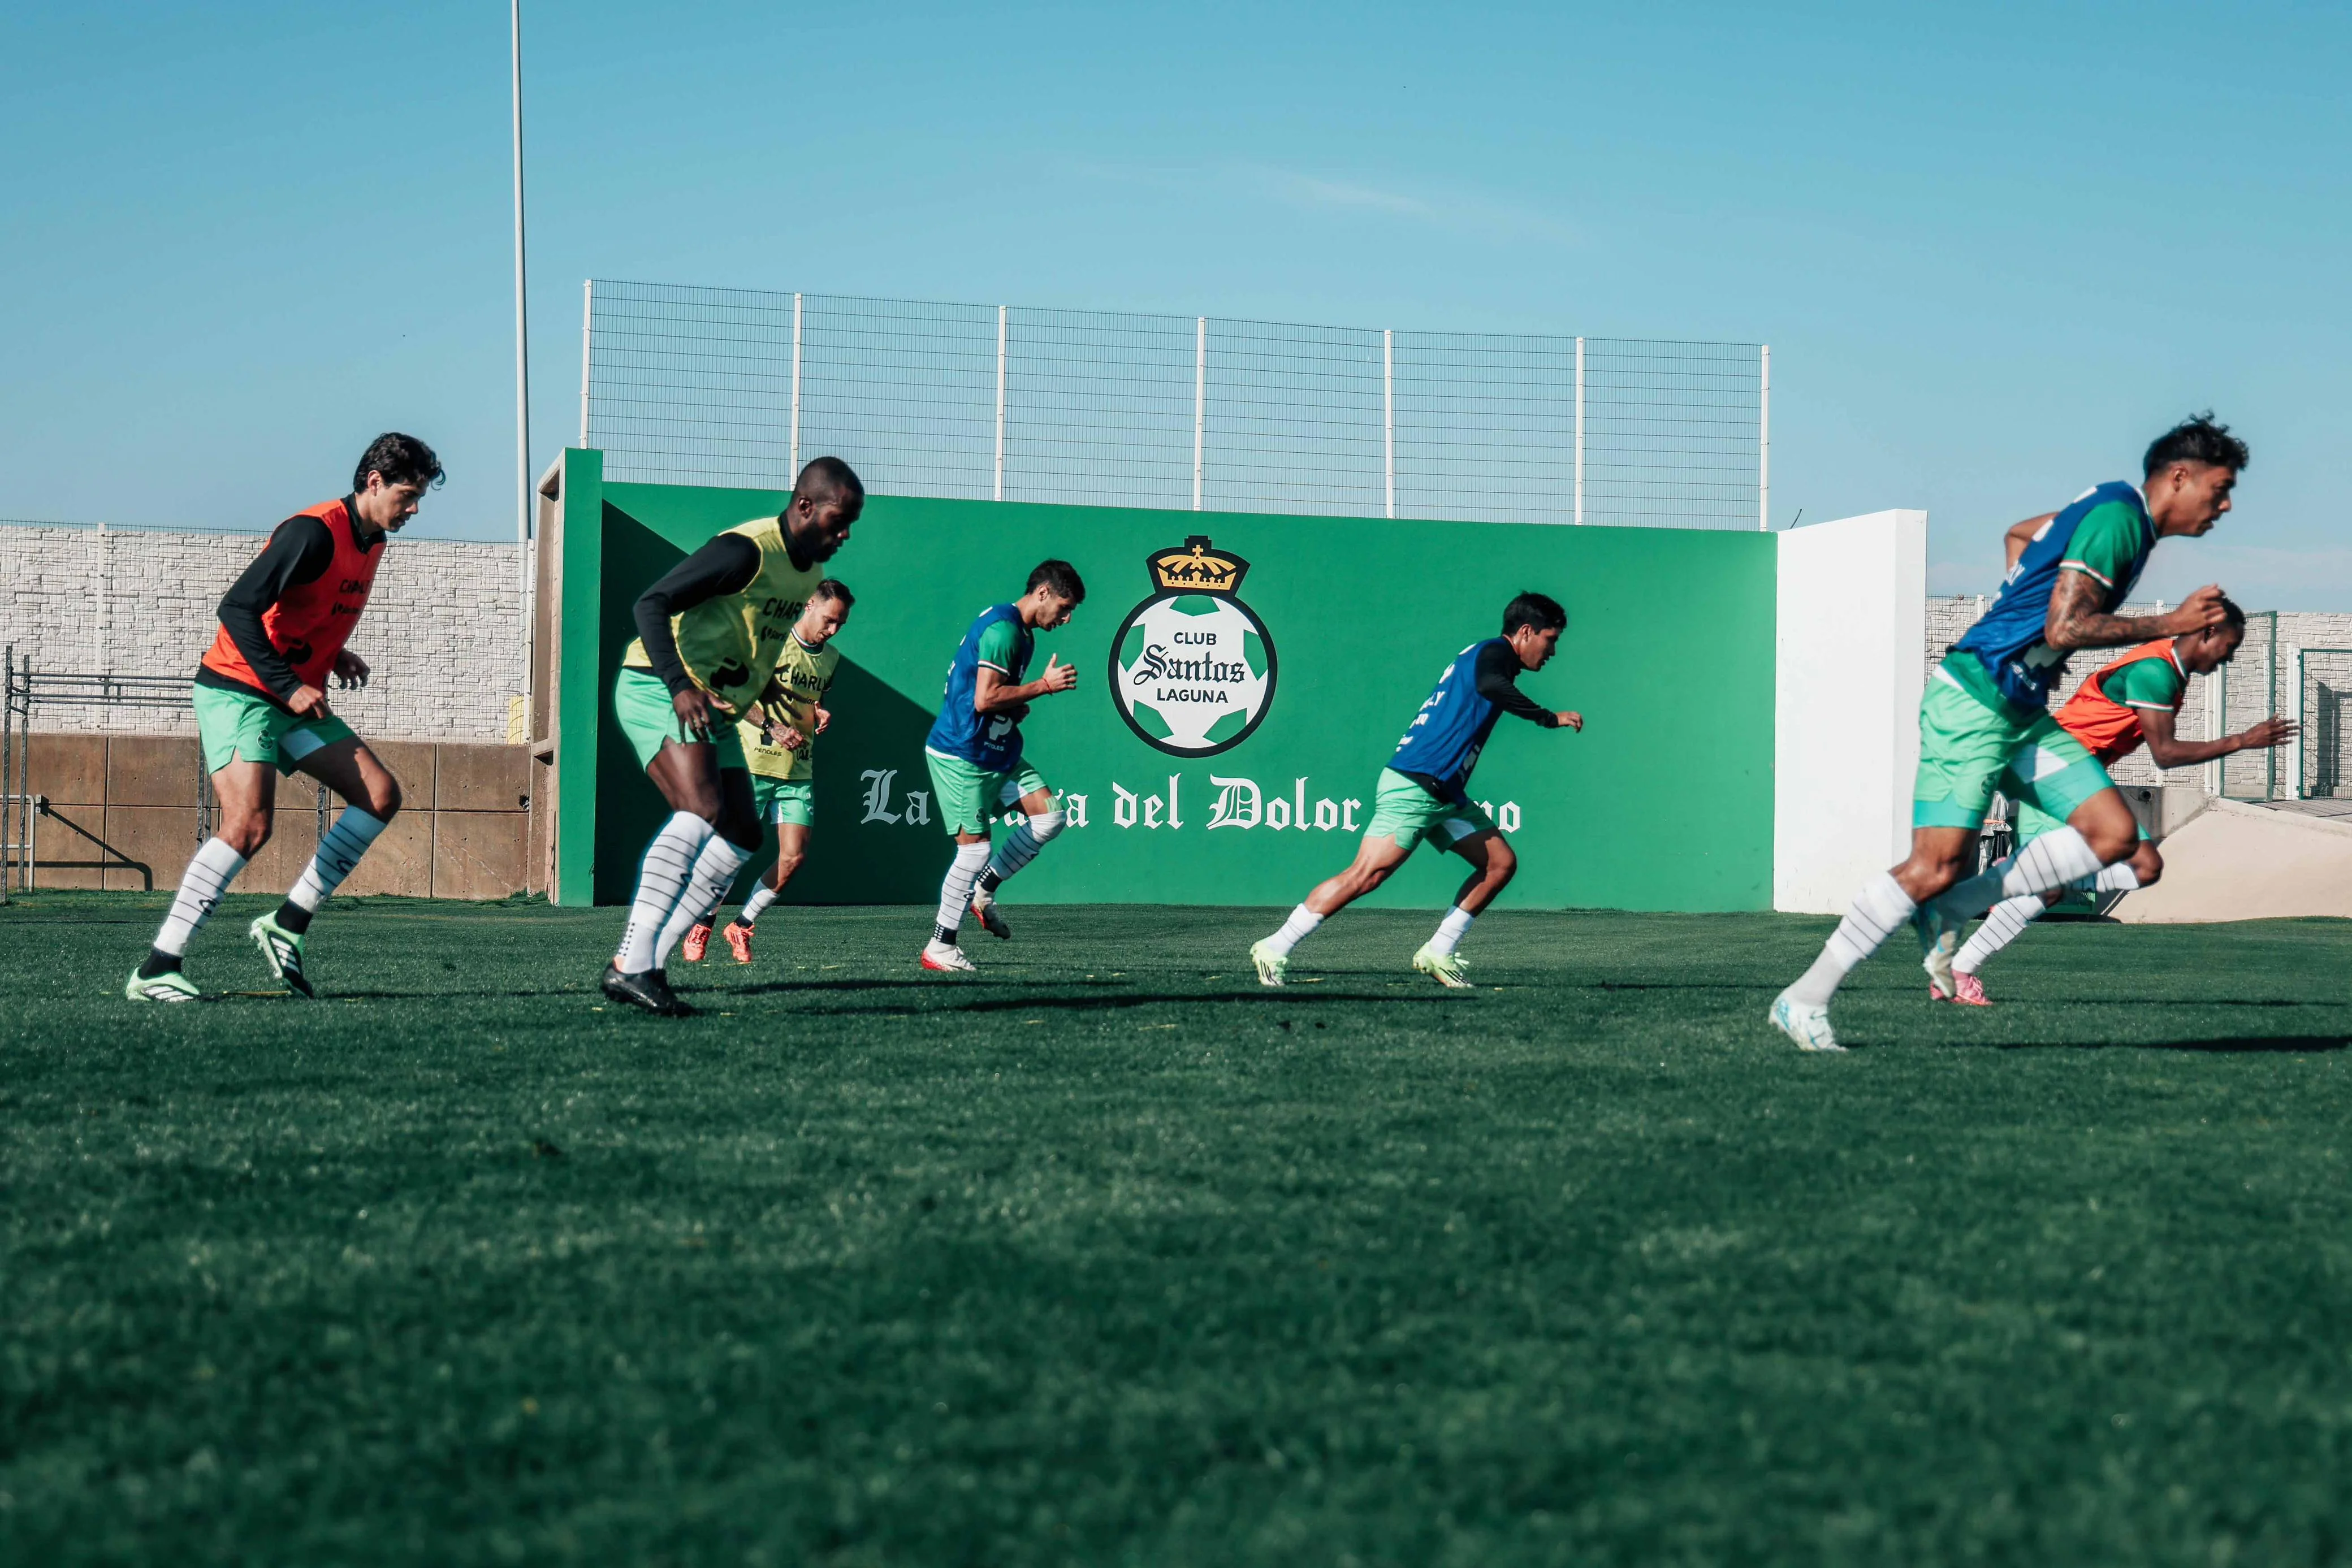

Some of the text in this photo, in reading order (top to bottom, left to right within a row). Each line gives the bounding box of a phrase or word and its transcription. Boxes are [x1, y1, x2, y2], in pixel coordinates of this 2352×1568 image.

[1174, 632, 1217, 646] CLUB
[1134, 644, 1245, 685] Santos
[1157, 688, 1229, 703] LAGUNA
[861, 769, 931, 825] La
[1112, 772, 1184, 830] del
[1205, 773, 1361, 833] Dolor
